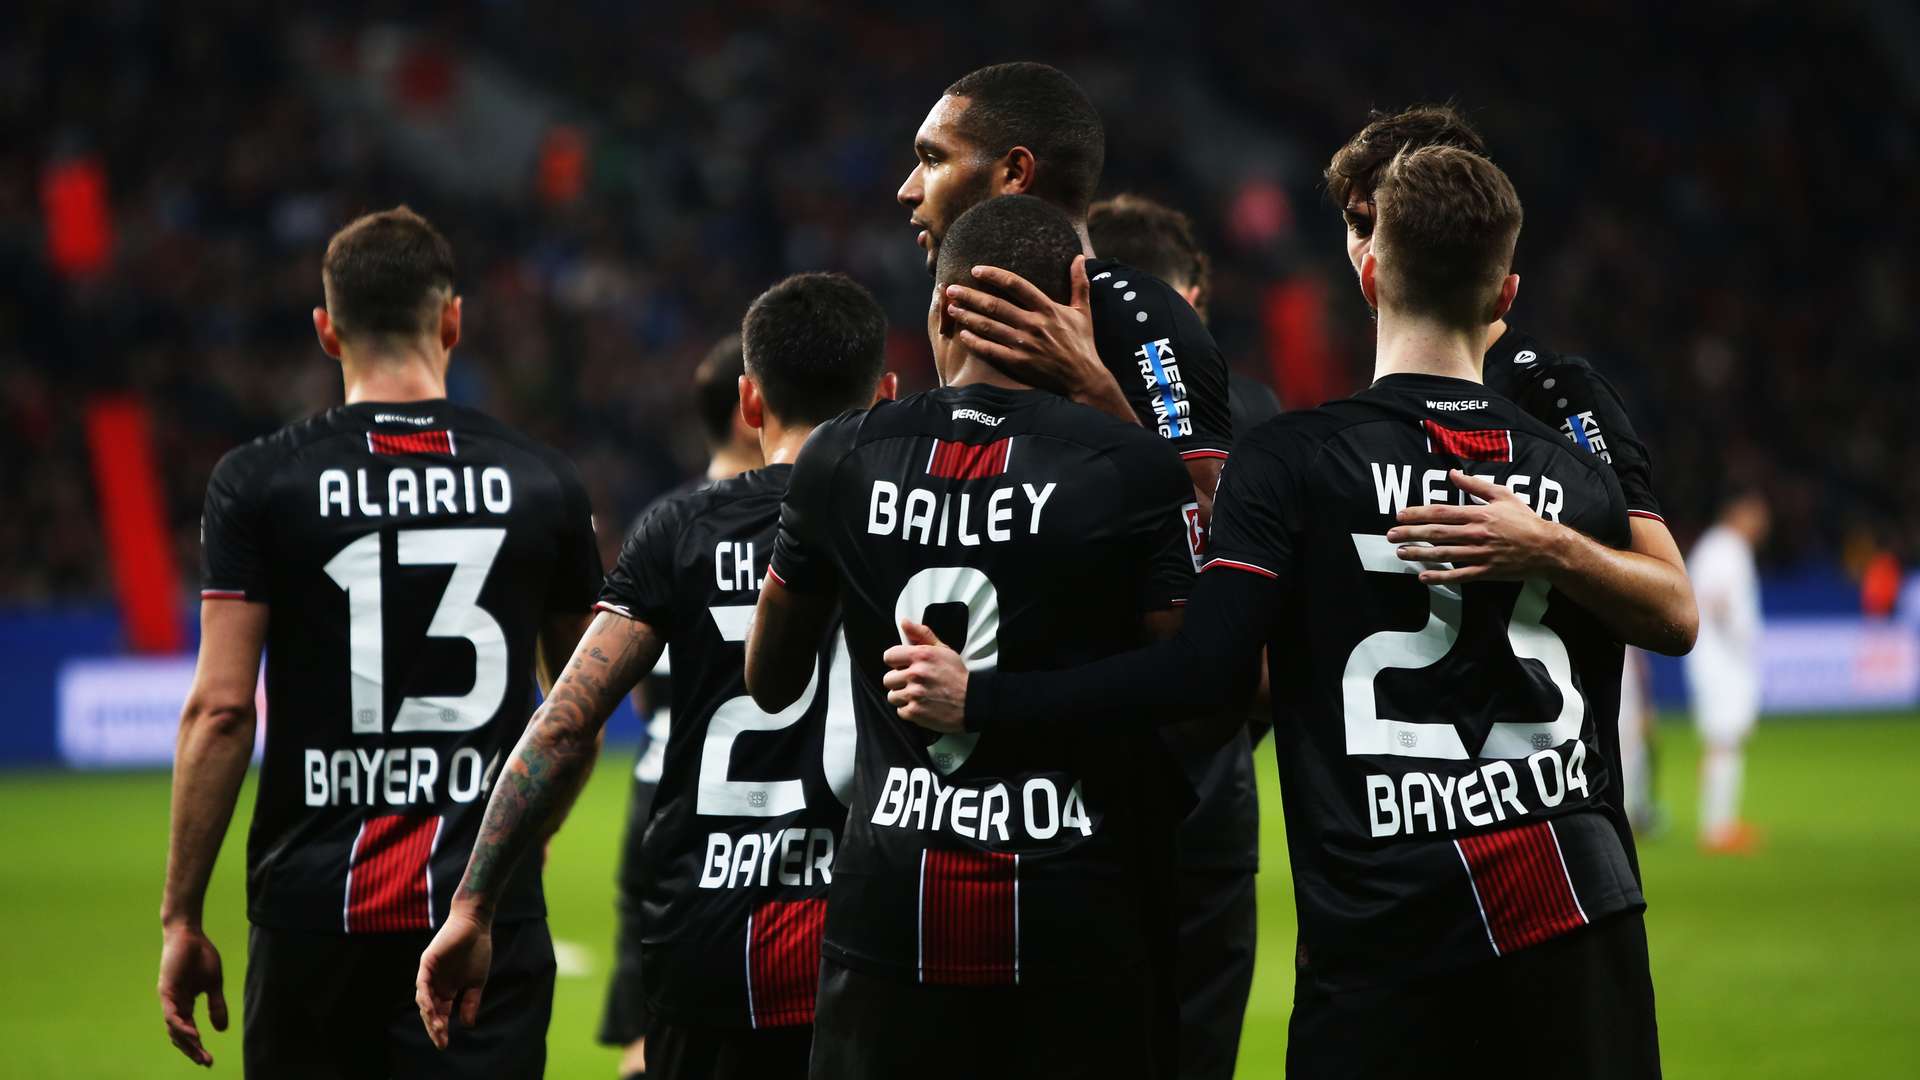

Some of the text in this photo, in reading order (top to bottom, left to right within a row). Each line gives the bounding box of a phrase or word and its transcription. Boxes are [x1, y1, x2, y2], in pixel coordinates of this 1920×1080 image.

[952, 409, 1006, 427] WERKSELF
[1154, 338, 1193, 437] KIESER
[1426, 400, 1489, 411] WERKSELF
[319, 467, 512, 518] ALARIO
[868, 480, 1056, 546] BAILEY
[323, 528, 508, 734] 13
[1342, 533, 1585, 761] 23
[895, 567, 1000, 776] 9
[305, 748, 439, 806] BAYER
[871, 767, 1093, 841] BAYER 04
[1366, 740, 1589, 838] BAYER 04
[699, 827, 834, 889] BAYER
